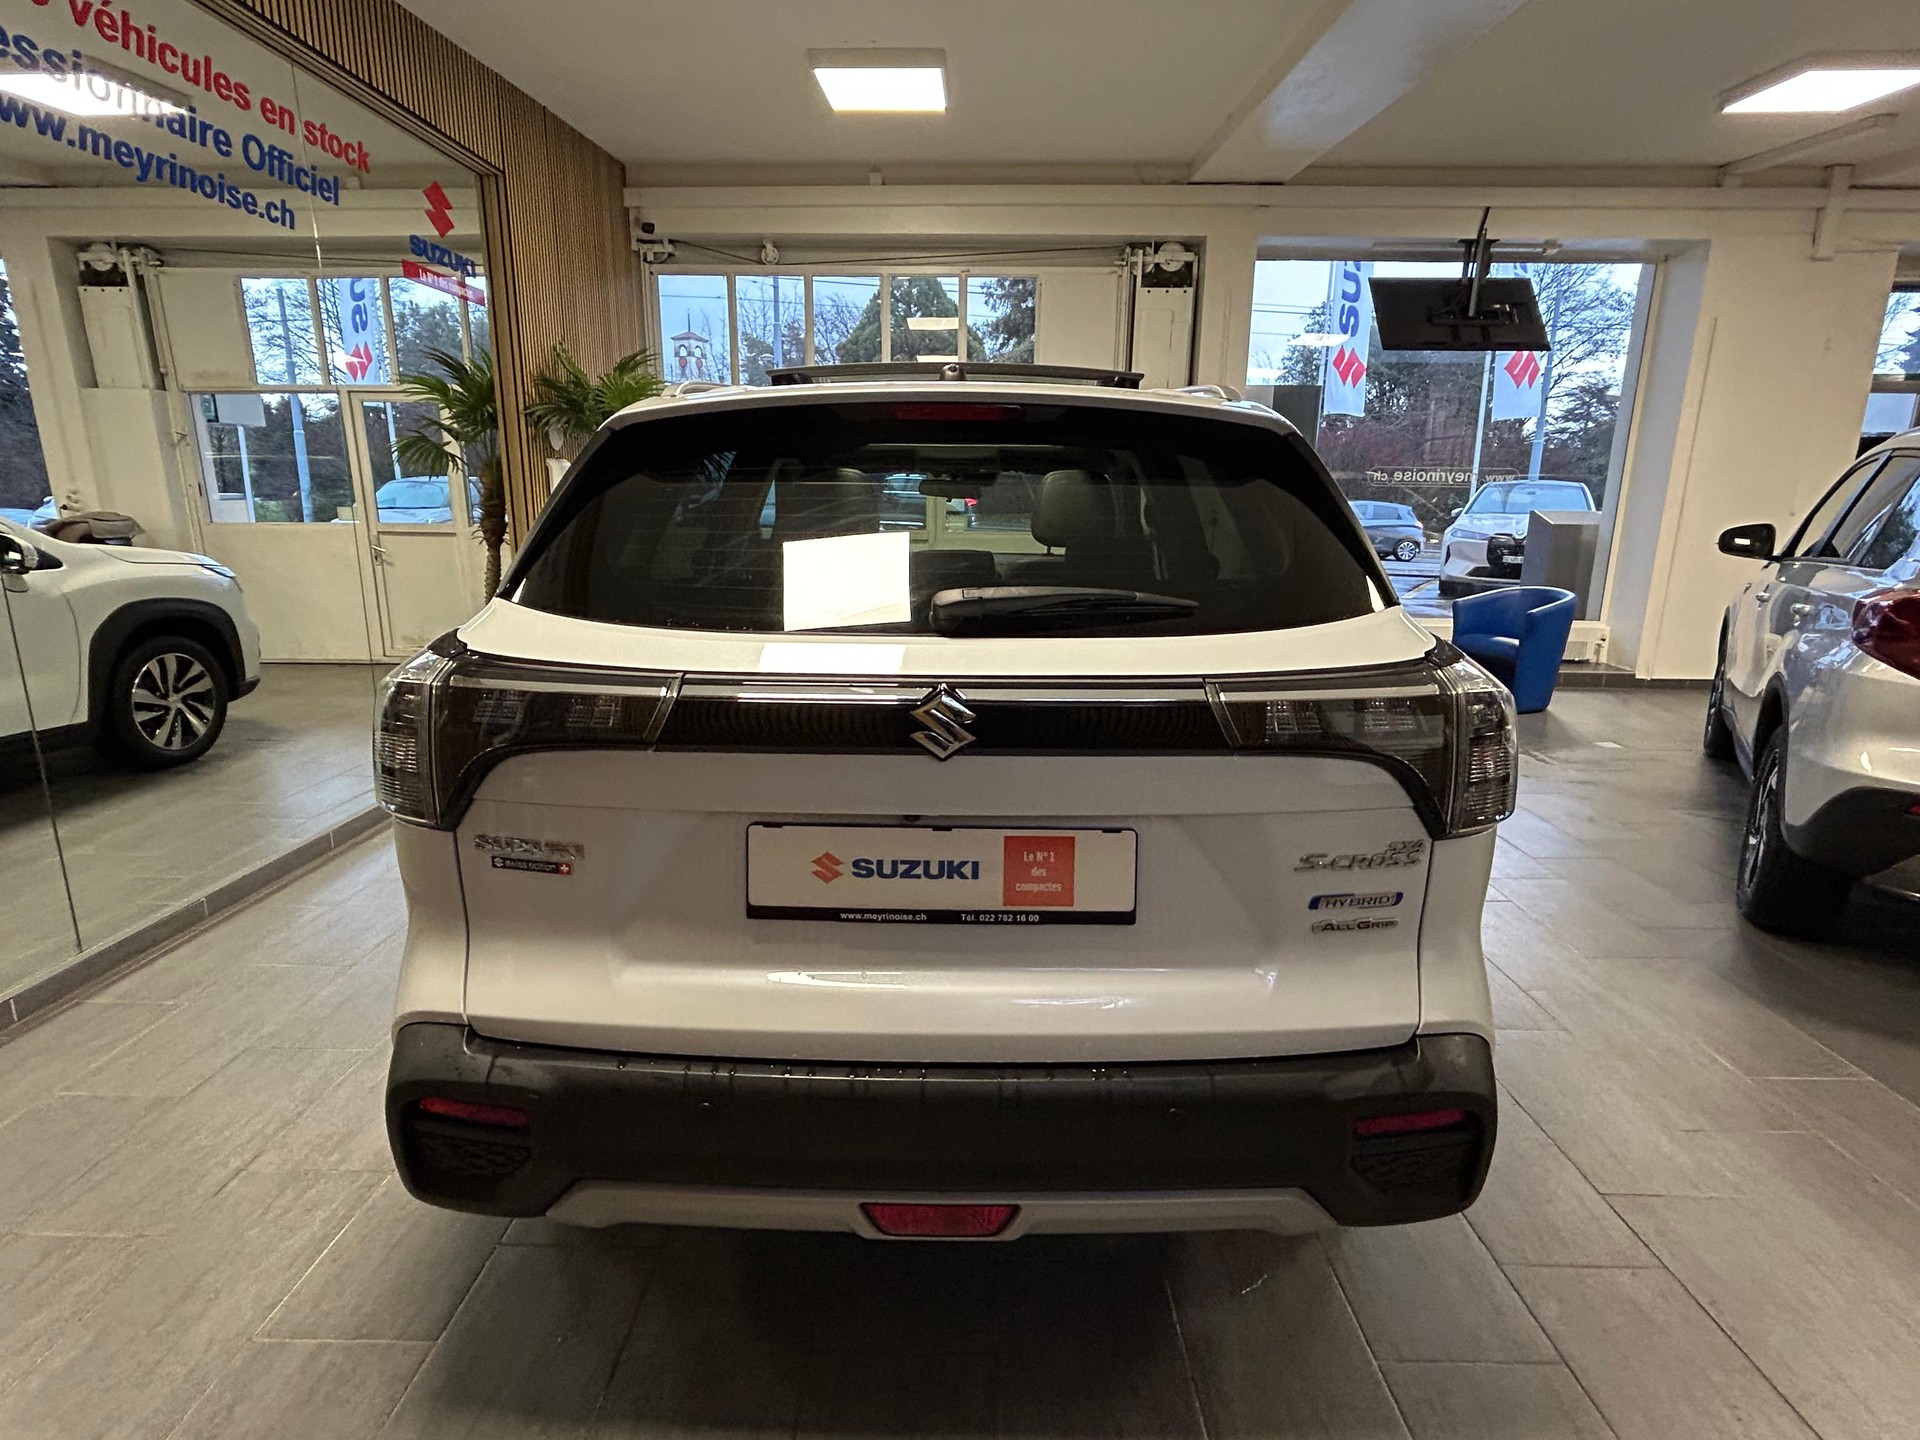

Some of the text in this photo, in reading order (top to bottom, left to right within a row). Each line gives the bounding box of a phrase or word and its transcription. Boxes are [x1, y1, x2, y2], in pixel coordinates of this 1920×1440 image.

[69, 0, 371, 174] véhicules en stock
[242, 134, 339, 206] Officiel
[409, 234, 477, 279] SUZUKI
[1023, 851, 1034, 862] Le
[851, 858, 980, 881] SUZUKI
[1031, 866, 1047, 877] des
[1324, 896, 1391, 909] HYBRID
[840, 912, 927, 922] www.meyrinoise.ch
[979, 914, 996, 922] 022
[998, 914, 1013, 922] 782
[1028, 914, 1040, 922] 00
